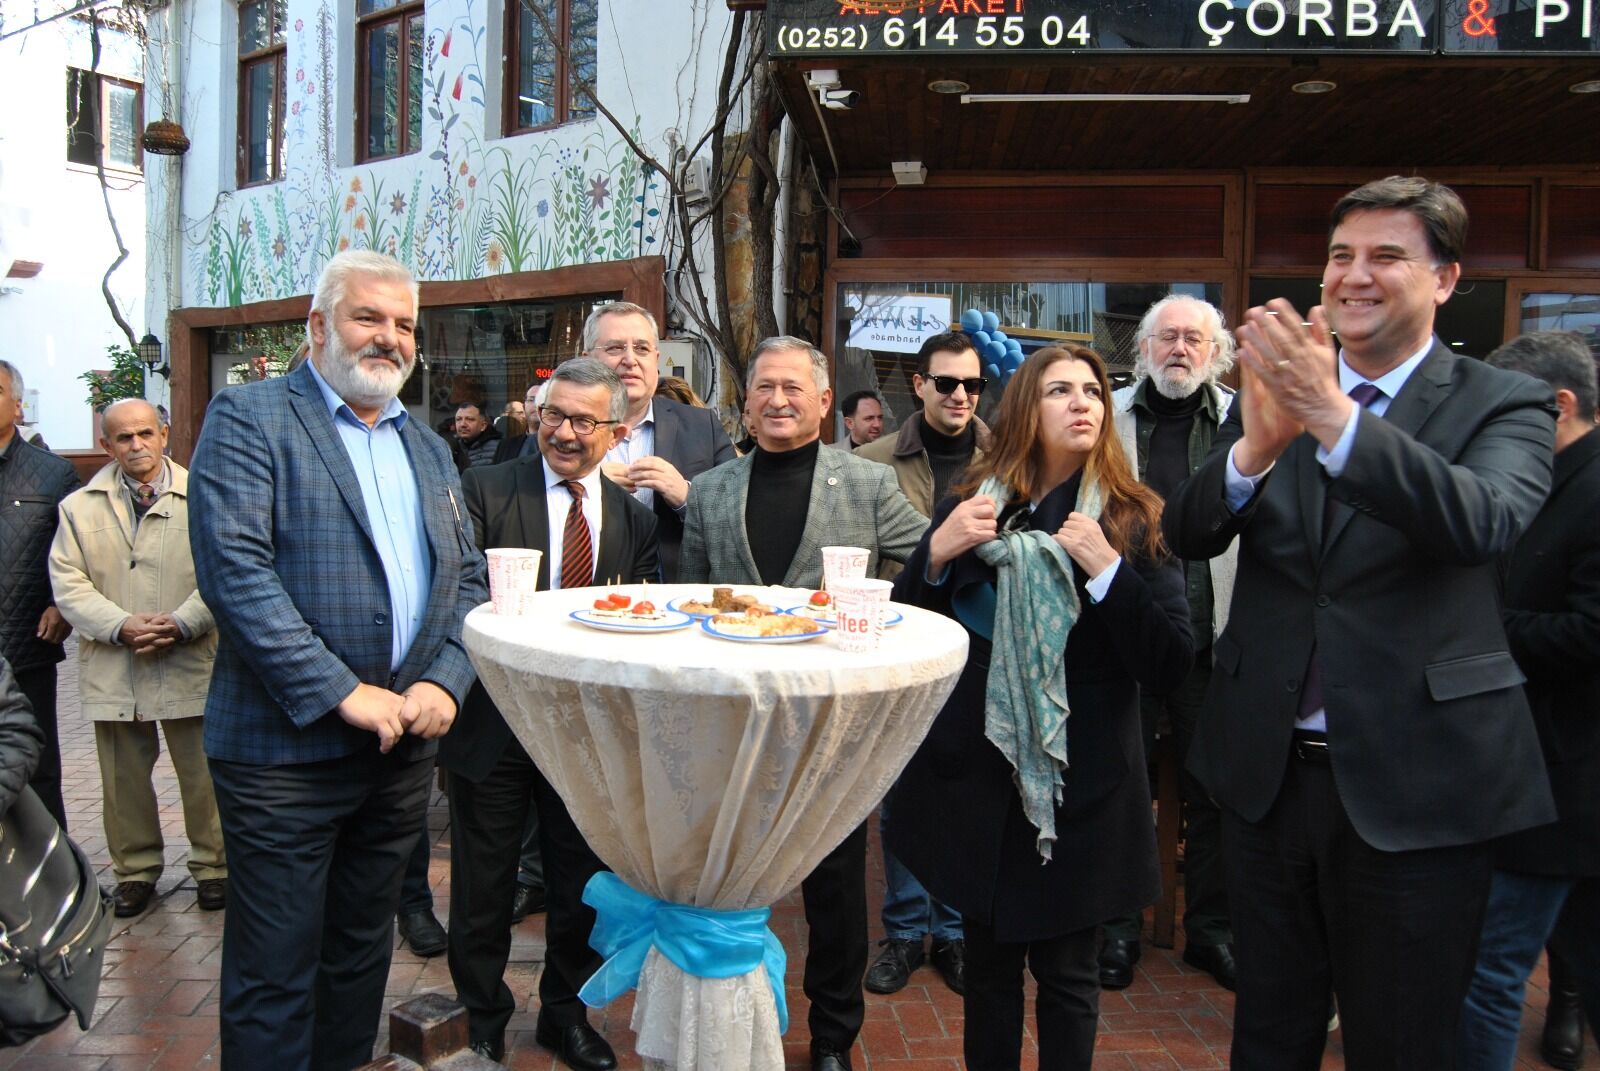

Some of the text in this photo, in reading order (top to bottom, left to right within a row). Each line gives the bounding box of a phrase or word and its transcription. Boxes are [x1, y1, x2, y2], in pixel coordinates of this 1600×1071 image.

[777, 15, 1091, 50] (0252) 614 55 04
[1197, 0, 1427, 47] ÇORBA
[1462, 0, 1497, 36] &
